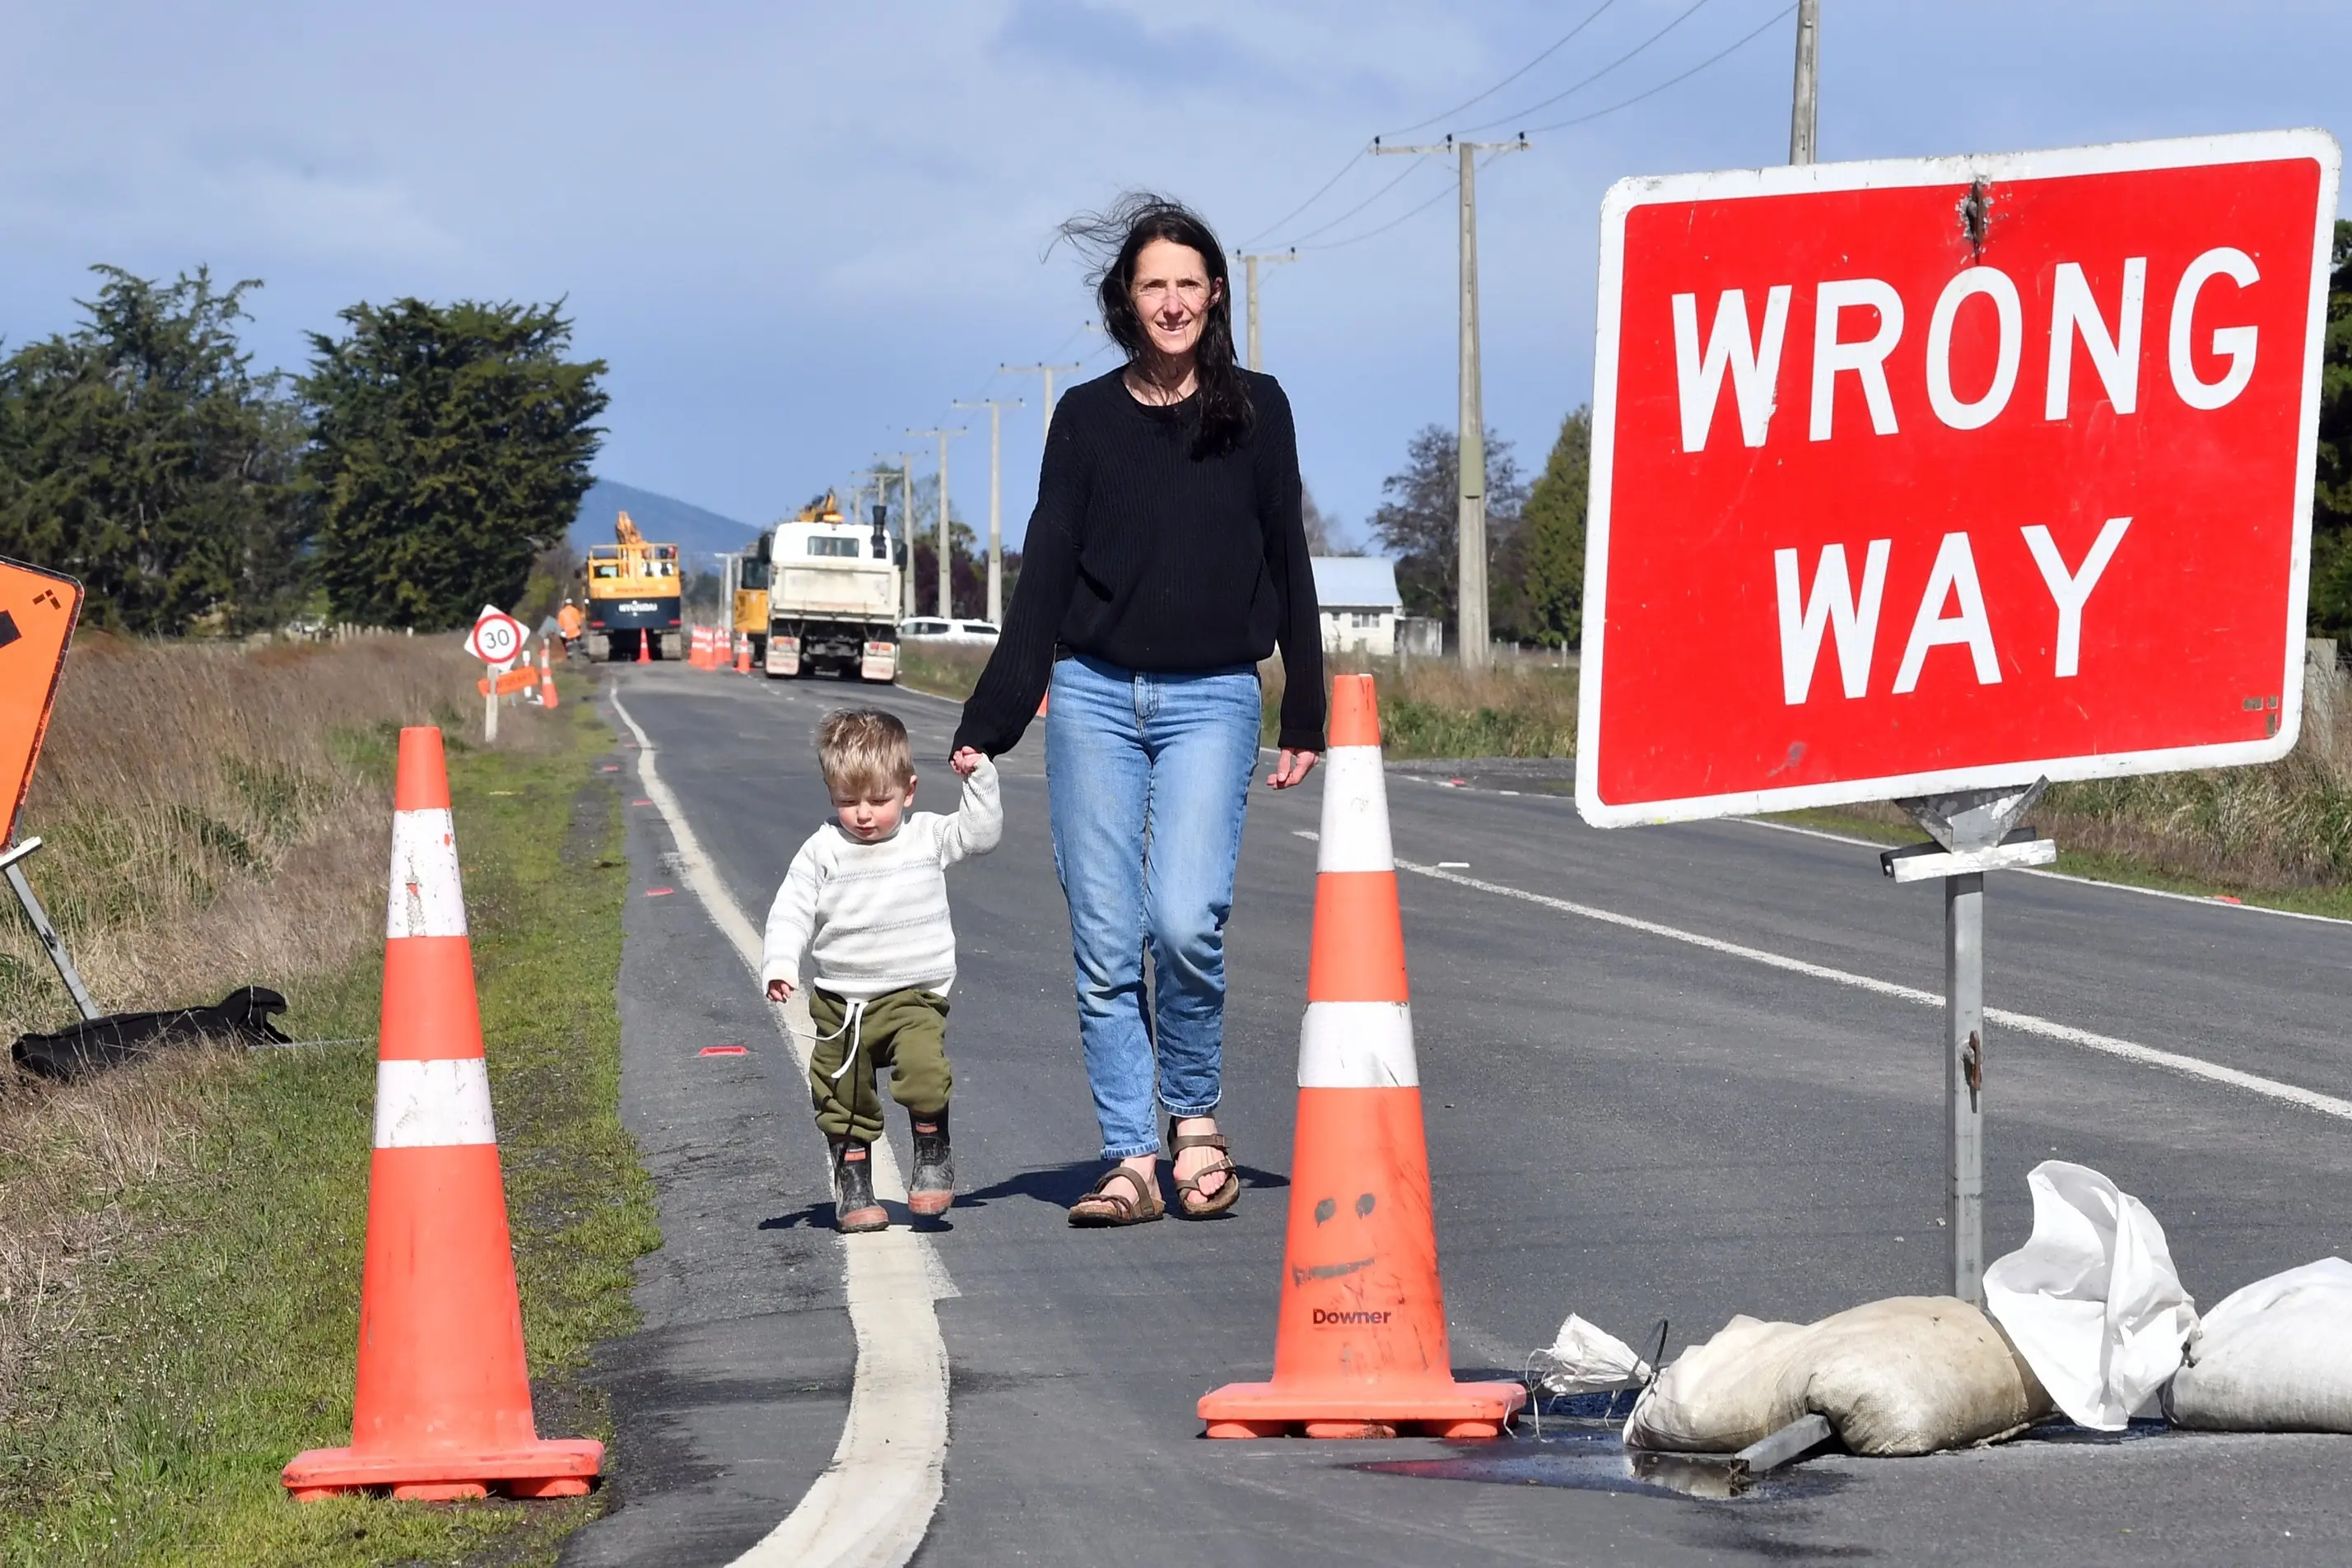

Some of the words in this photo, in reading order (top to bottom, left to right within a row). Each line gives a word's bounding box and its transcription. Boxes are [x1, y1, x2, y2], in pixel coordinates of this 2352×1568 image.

[1671, 246, 2261, 454] WRONG
[484, 629, 510, 649] 30
[1774, 516, 2133, 705] WAY
[1313, 1308, 1391, 1324] Downer
